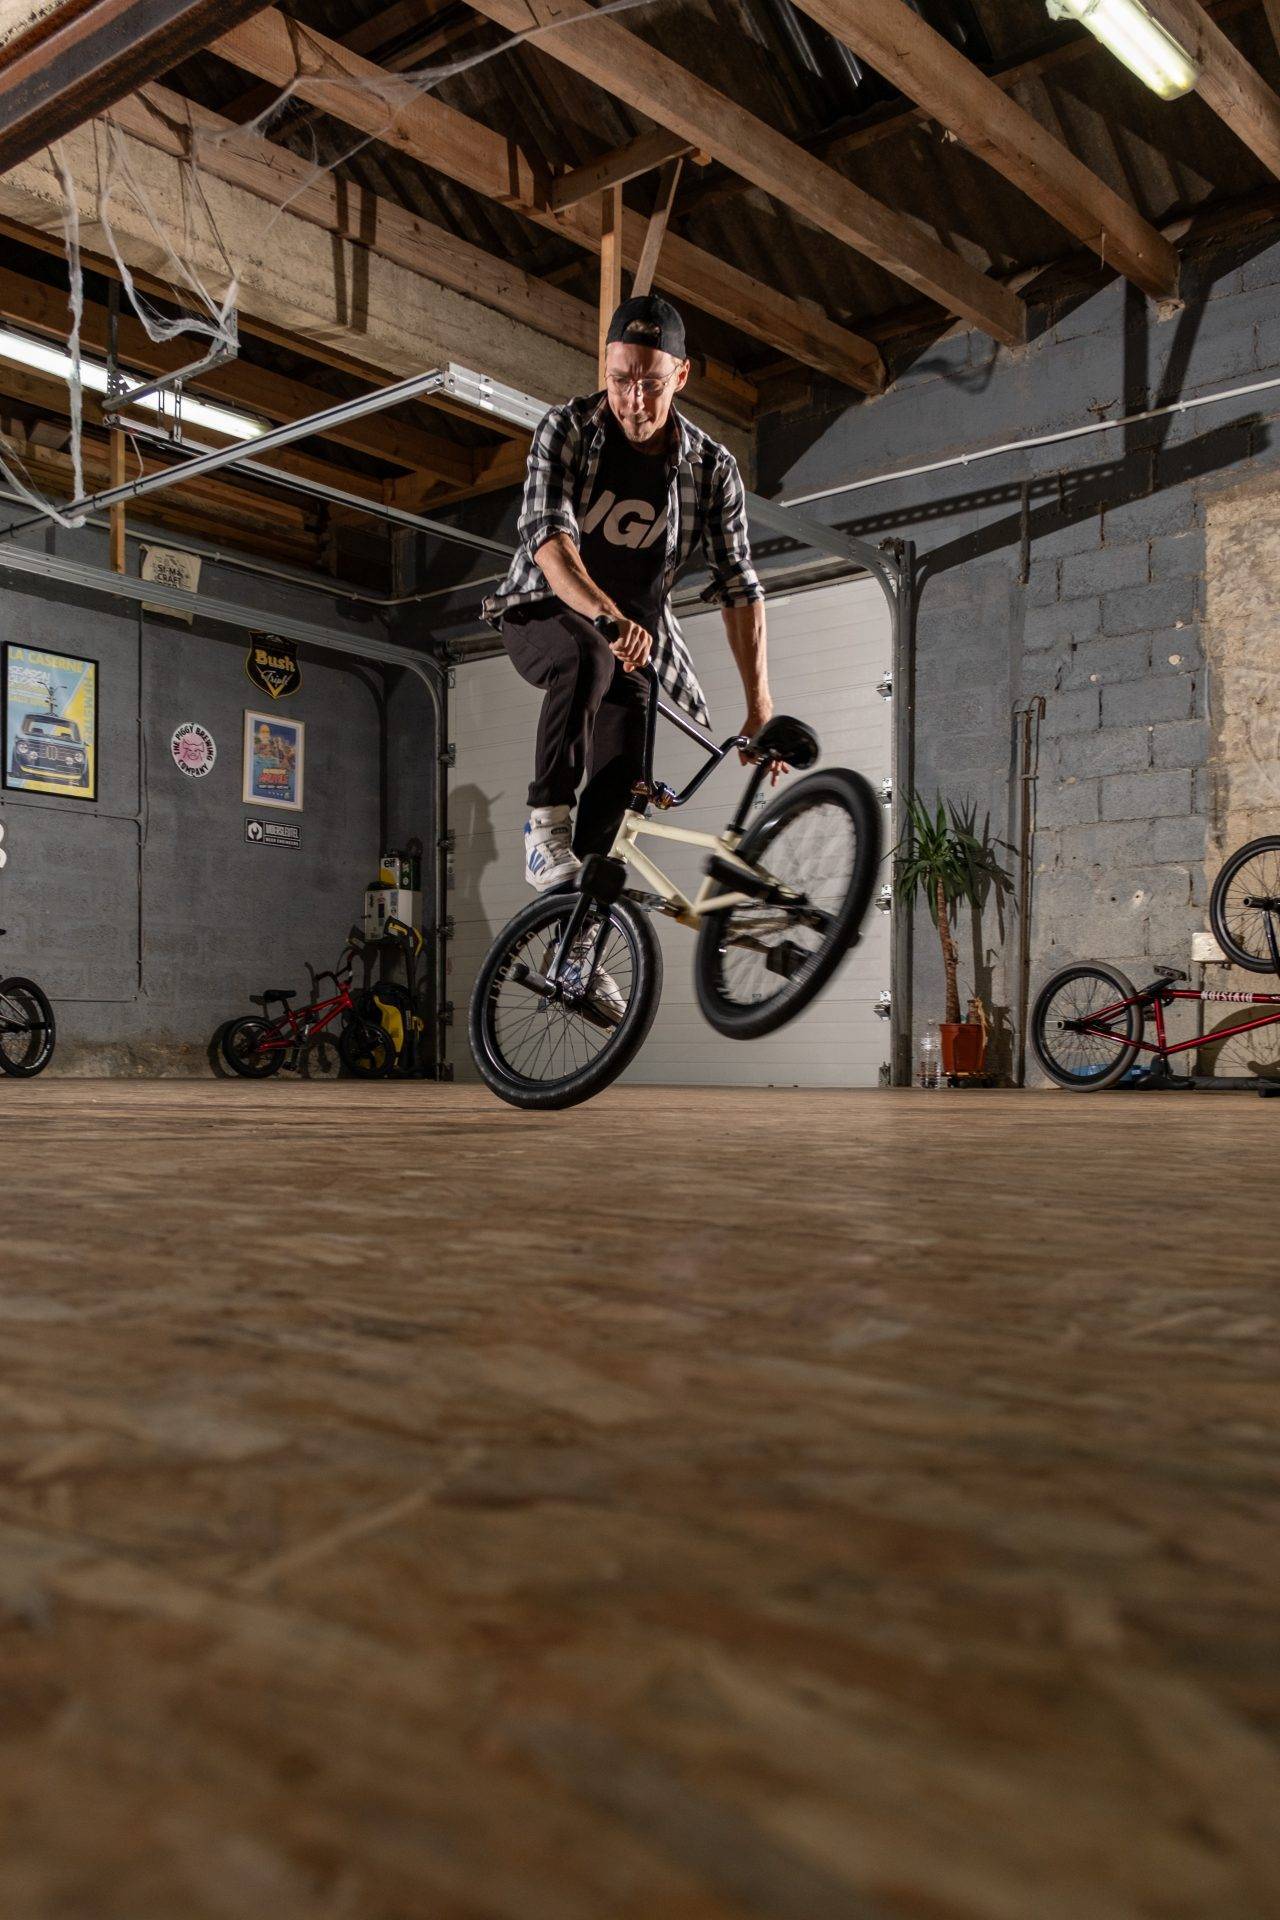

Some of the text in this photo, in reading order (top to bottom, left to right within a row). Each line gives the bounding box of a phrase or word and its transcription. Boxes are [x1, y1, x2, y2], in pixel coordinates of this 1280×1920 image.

[8, 646, 83, 674] LA CASERNE
[255, 649, 296, 672] Bush
[175, 725, 194, 741] PIGGY
[195, 727, 214, 762] BREWING
[178, 759, 208, 775] COMPANY
[384, 859, 396, 868] elf
